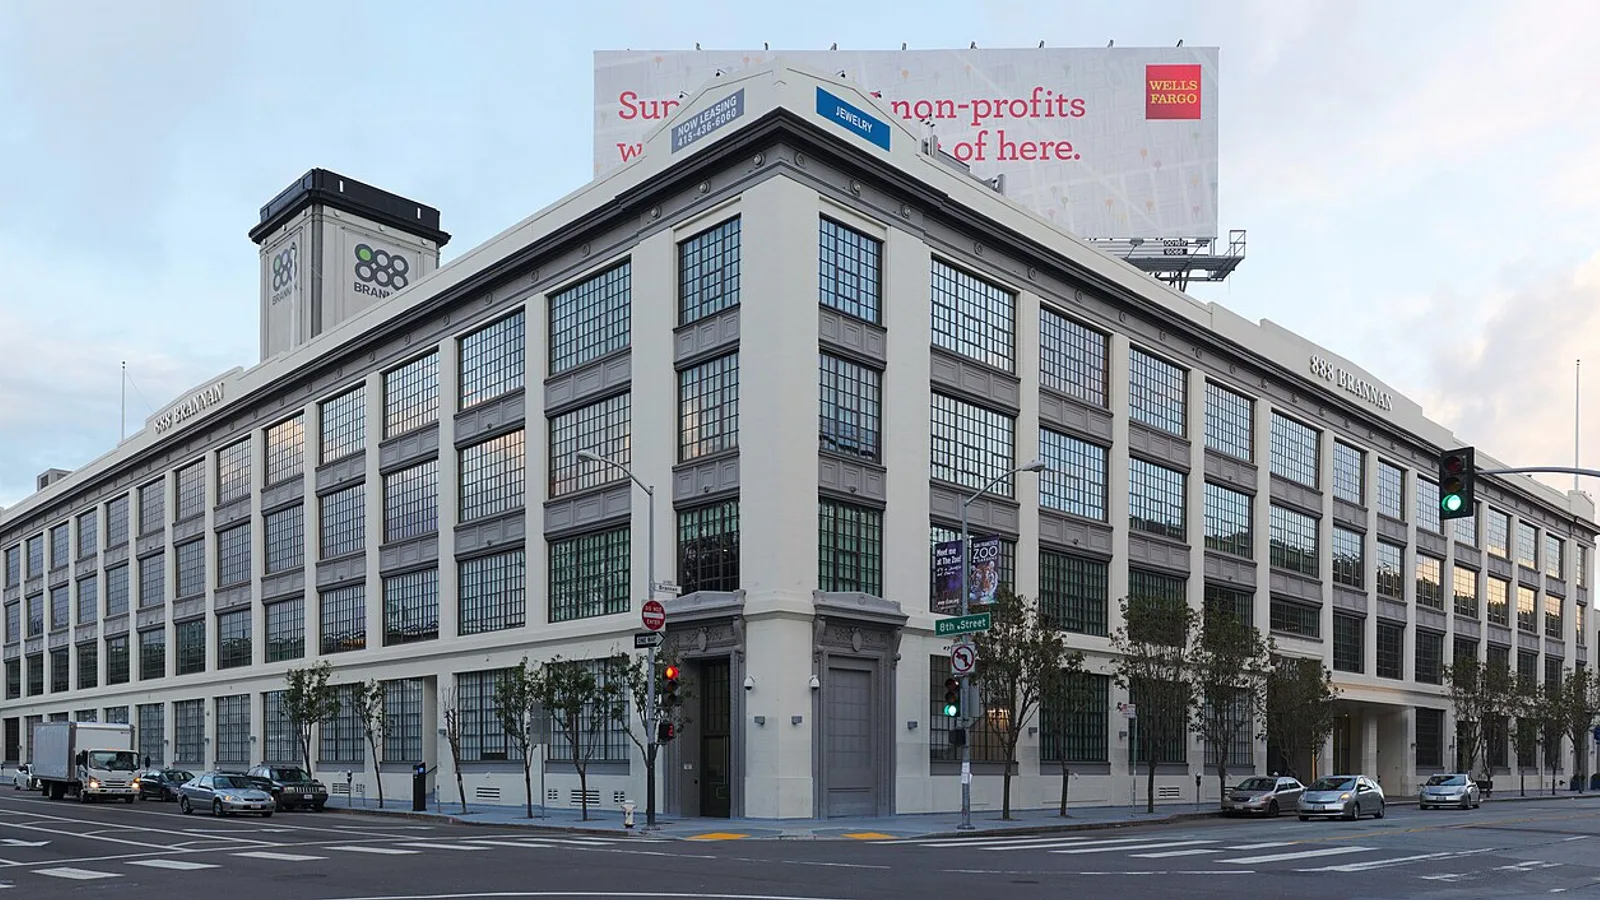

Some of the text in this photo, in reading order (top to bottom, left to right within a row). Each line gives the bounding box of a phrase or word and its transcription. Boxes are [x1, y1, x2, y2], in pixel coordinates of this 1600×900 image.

[1149, 80, 1198, 91] WELLS
[1151, 93, 1197, 104] FARGO
[678, 95, 737, 137] NOW LEASING
[835, 106, 873, 133] JEWELRY
[891, 86, 1086, 126] non-profits
[677, 108, 737, 147] 415-436-6060
[953, 130, 988, 161] of
[997, 130, 1081, 161] here.
[1310, 355, 1393, 411] 888 BRANNAN
[154, 382, 224, 435] 888 BRANNAN
[973, 545, 998, 559] ZOO
[940, 617, 986, 632] 8th Street
